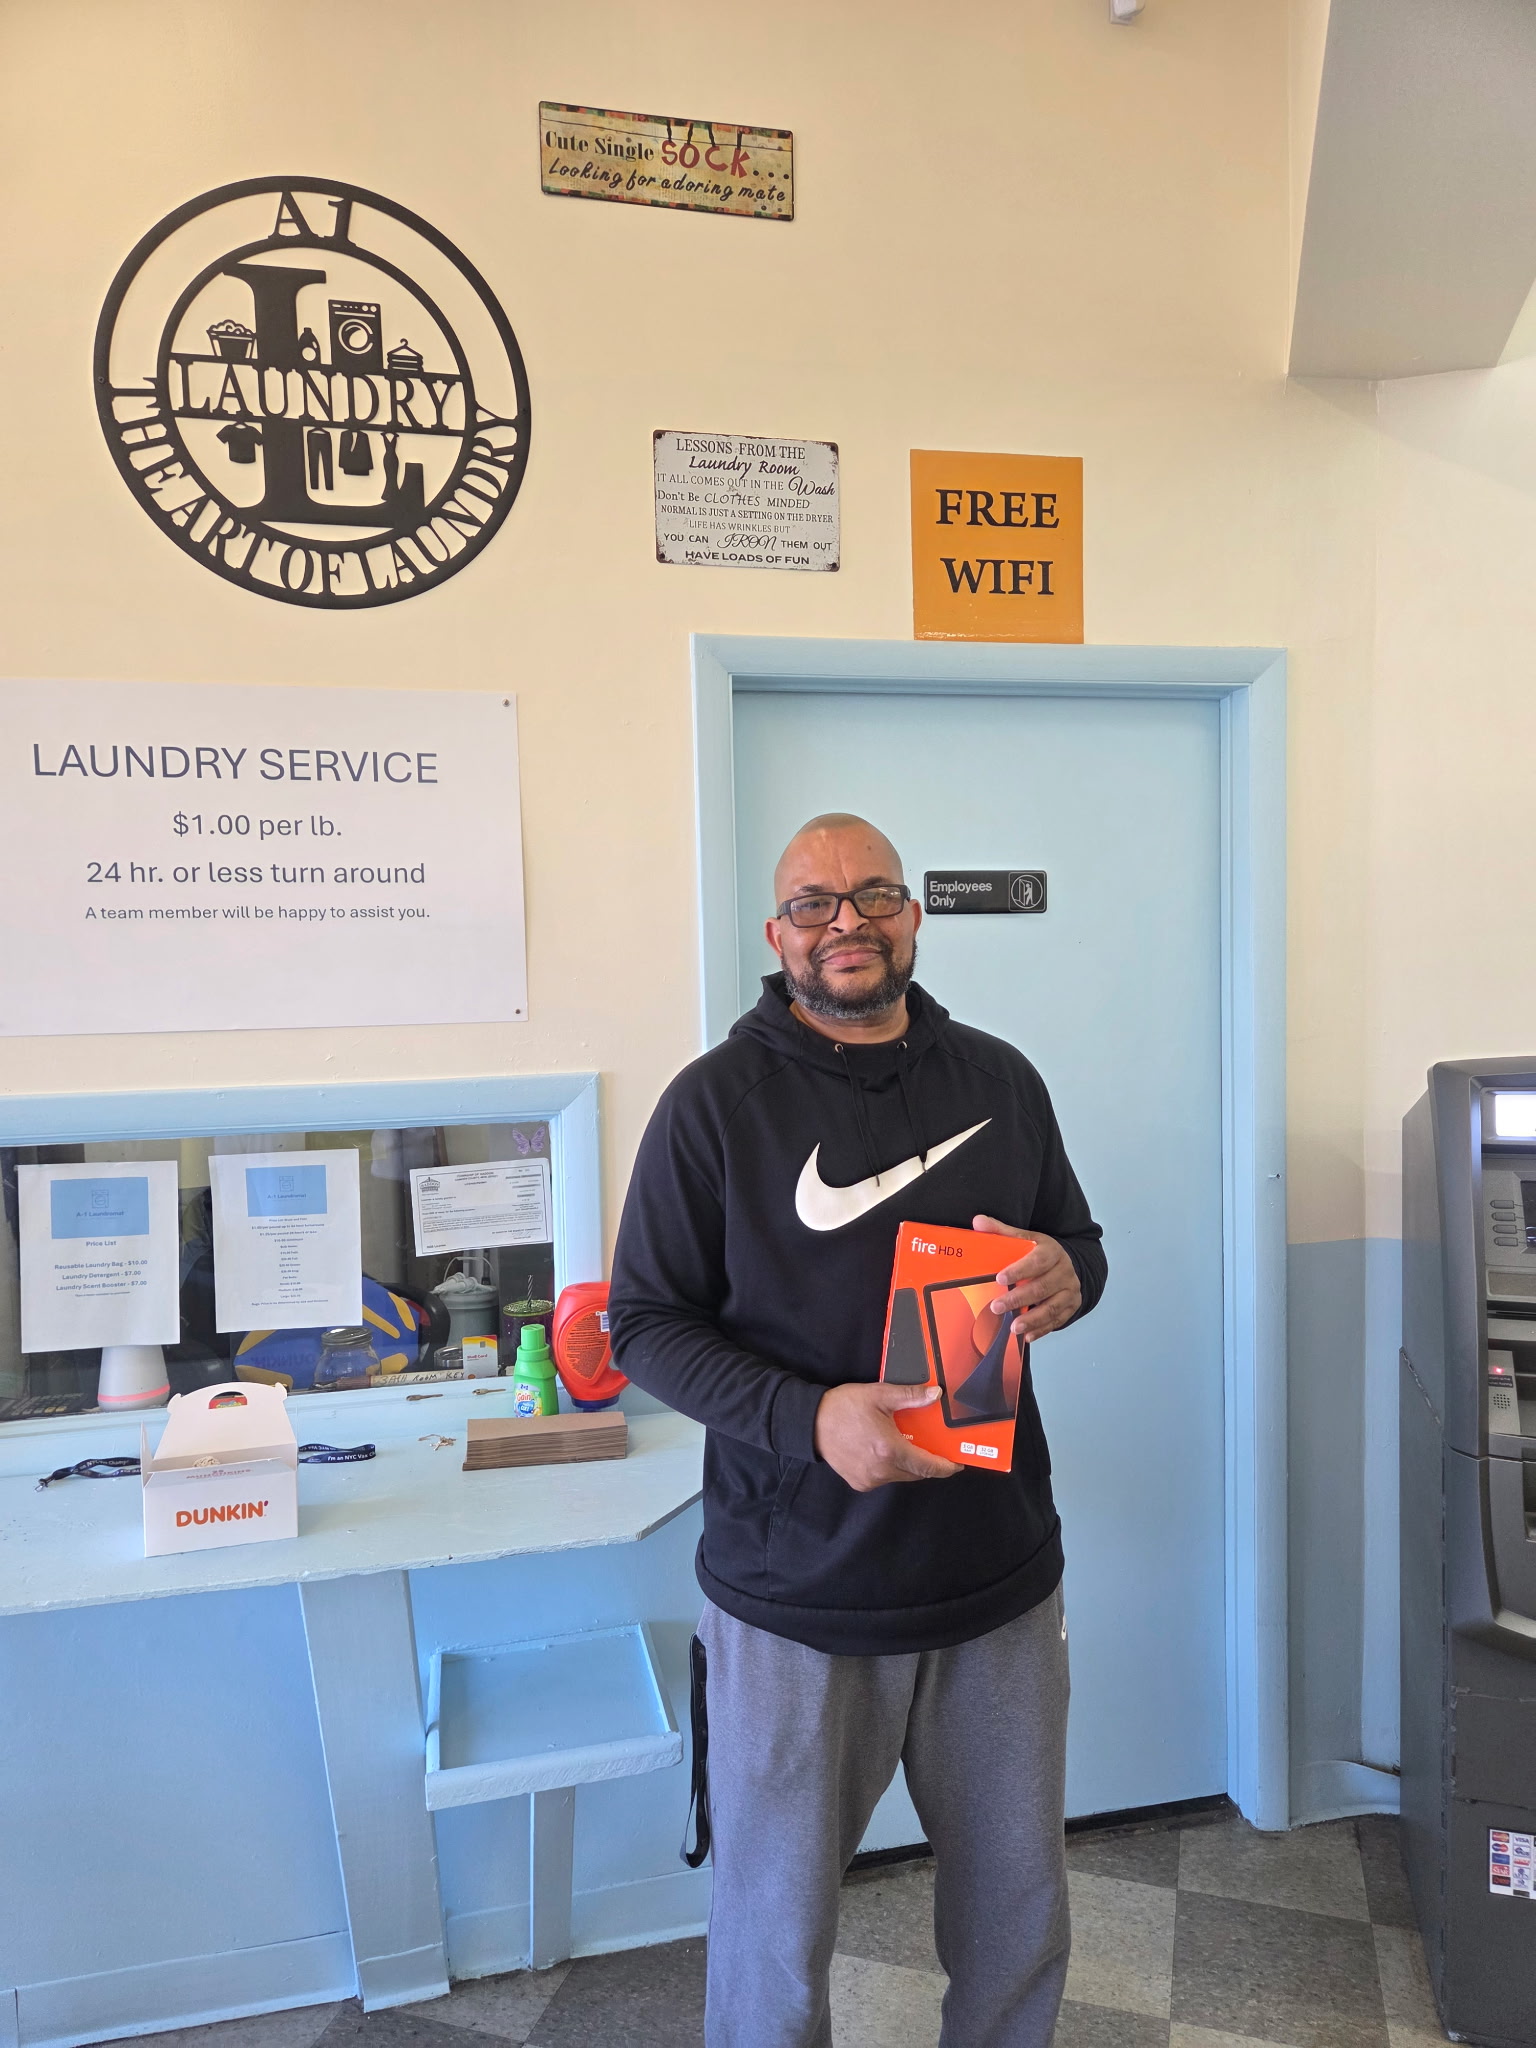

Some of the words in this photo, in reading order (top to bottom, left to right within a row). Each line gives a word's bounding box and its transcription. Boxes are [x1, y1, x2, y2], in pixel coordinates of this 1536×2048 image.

[546, 131, 589, 149] Cute
[595, 137, 654, 163] Single
[549, 157, 623, 190] Looking
[627, 169, 657, 191] for
[661, 174, 734, 201] adoring
[738, 186, 787, 202] mate
[268, 191, 357, 247] A1
[171, 359, 456, 431] LAUNDRY
[676, 438, 733, 455] LESSONS
[739, 442, 776, 458] FROM
[779, 446, 806, 460] THE
[689, 456, 752, 480] Laundry
[758, 460, 800, 475] Room
[657, 473, 667, 483] IT
[669, 474, 689, 485] ALL
[690, 475, 725, 487] COMES
[727, 477, 748, 489] OUT
[750, 479, 761, 489] IN
[763, 480, 784, 491] THE
[788, 476, 836, 496] Wash
[168, 495, 276, 575] ART
[279, 546, 346, 597] OF
[362, 402, 518, 596] LAUNDRY
[657, 490, 685, 501] Don't
[688, 492, 700, 502] Be
[704, 493, 761, 507] CLOTHES
[767, 497, 810, 509] MINDED
[935, 488, 1060, 529] FREE
[661, 504, 698, 516] NORMAL
[699, 506, 707, 516] IS
[708, 507, 730, 518] JUST
[730, 509, 737, 518] A
[738, 510, 773, 521] SETTING
[774, 512, 786, 521] ON
[786, 513, 805, 522] THE
[805, 514, 833, 524] DRYER
[689, 520, 708, 530] LIFE
[709, 521, 727, 530] HAS
[728, 522, 772, 533] WRINKLES
[774, 524, 791, 534] BUT
[664, 533, 684, 543] YOU
[689, 534, 709, 544] CAN
[781, 540, 809, 550] THEM
[813, 541, 833, 551] OUT
[685, 550, 720, 561] HAVE
[722, 552, 764, 563] LOADS
[765, 554, 782, 564] OF
[784, 556, 810, 565] FUN
[940, 557, 1054, 596] WIFI
[32, 743, 248, 780] LAUNDRY
[259, 748, 438, 784] SERVICE
[173, 810, 250, 837] $1.00
[259, 819, 303, 841] per
[311, 815, 342, 837] lb.
[86, 861, 122, 883] 24
[130, 861, 164, 883] hr.
[172, 866, 201, 883] or
[208, 861, 263, 883] less
[270, 863, 325, 883] turn
[333, 862, 425, 884] around
[929, 880, 993, 894] Employees
[929, 894, 956, 909] Only
[85, 906, 97, 919] A
[100, 907, 144, 919] team
[149, 906, 219, 919] member
[222, 905, 250, 919] will
[254, 905, 274, 919] be
[278, 905, 327, 921] happy
[330, 906, 346, 918] to
[350, 905, 395, 918] assist
[398, 907, 431, 921] you.
[911, 1237, 937, 1255] fire
[56, 1283, 82, 1291] Laundry
[62, 1272, 88, 1280] Laundry
[517, 1393, 531, 1402] Gain
